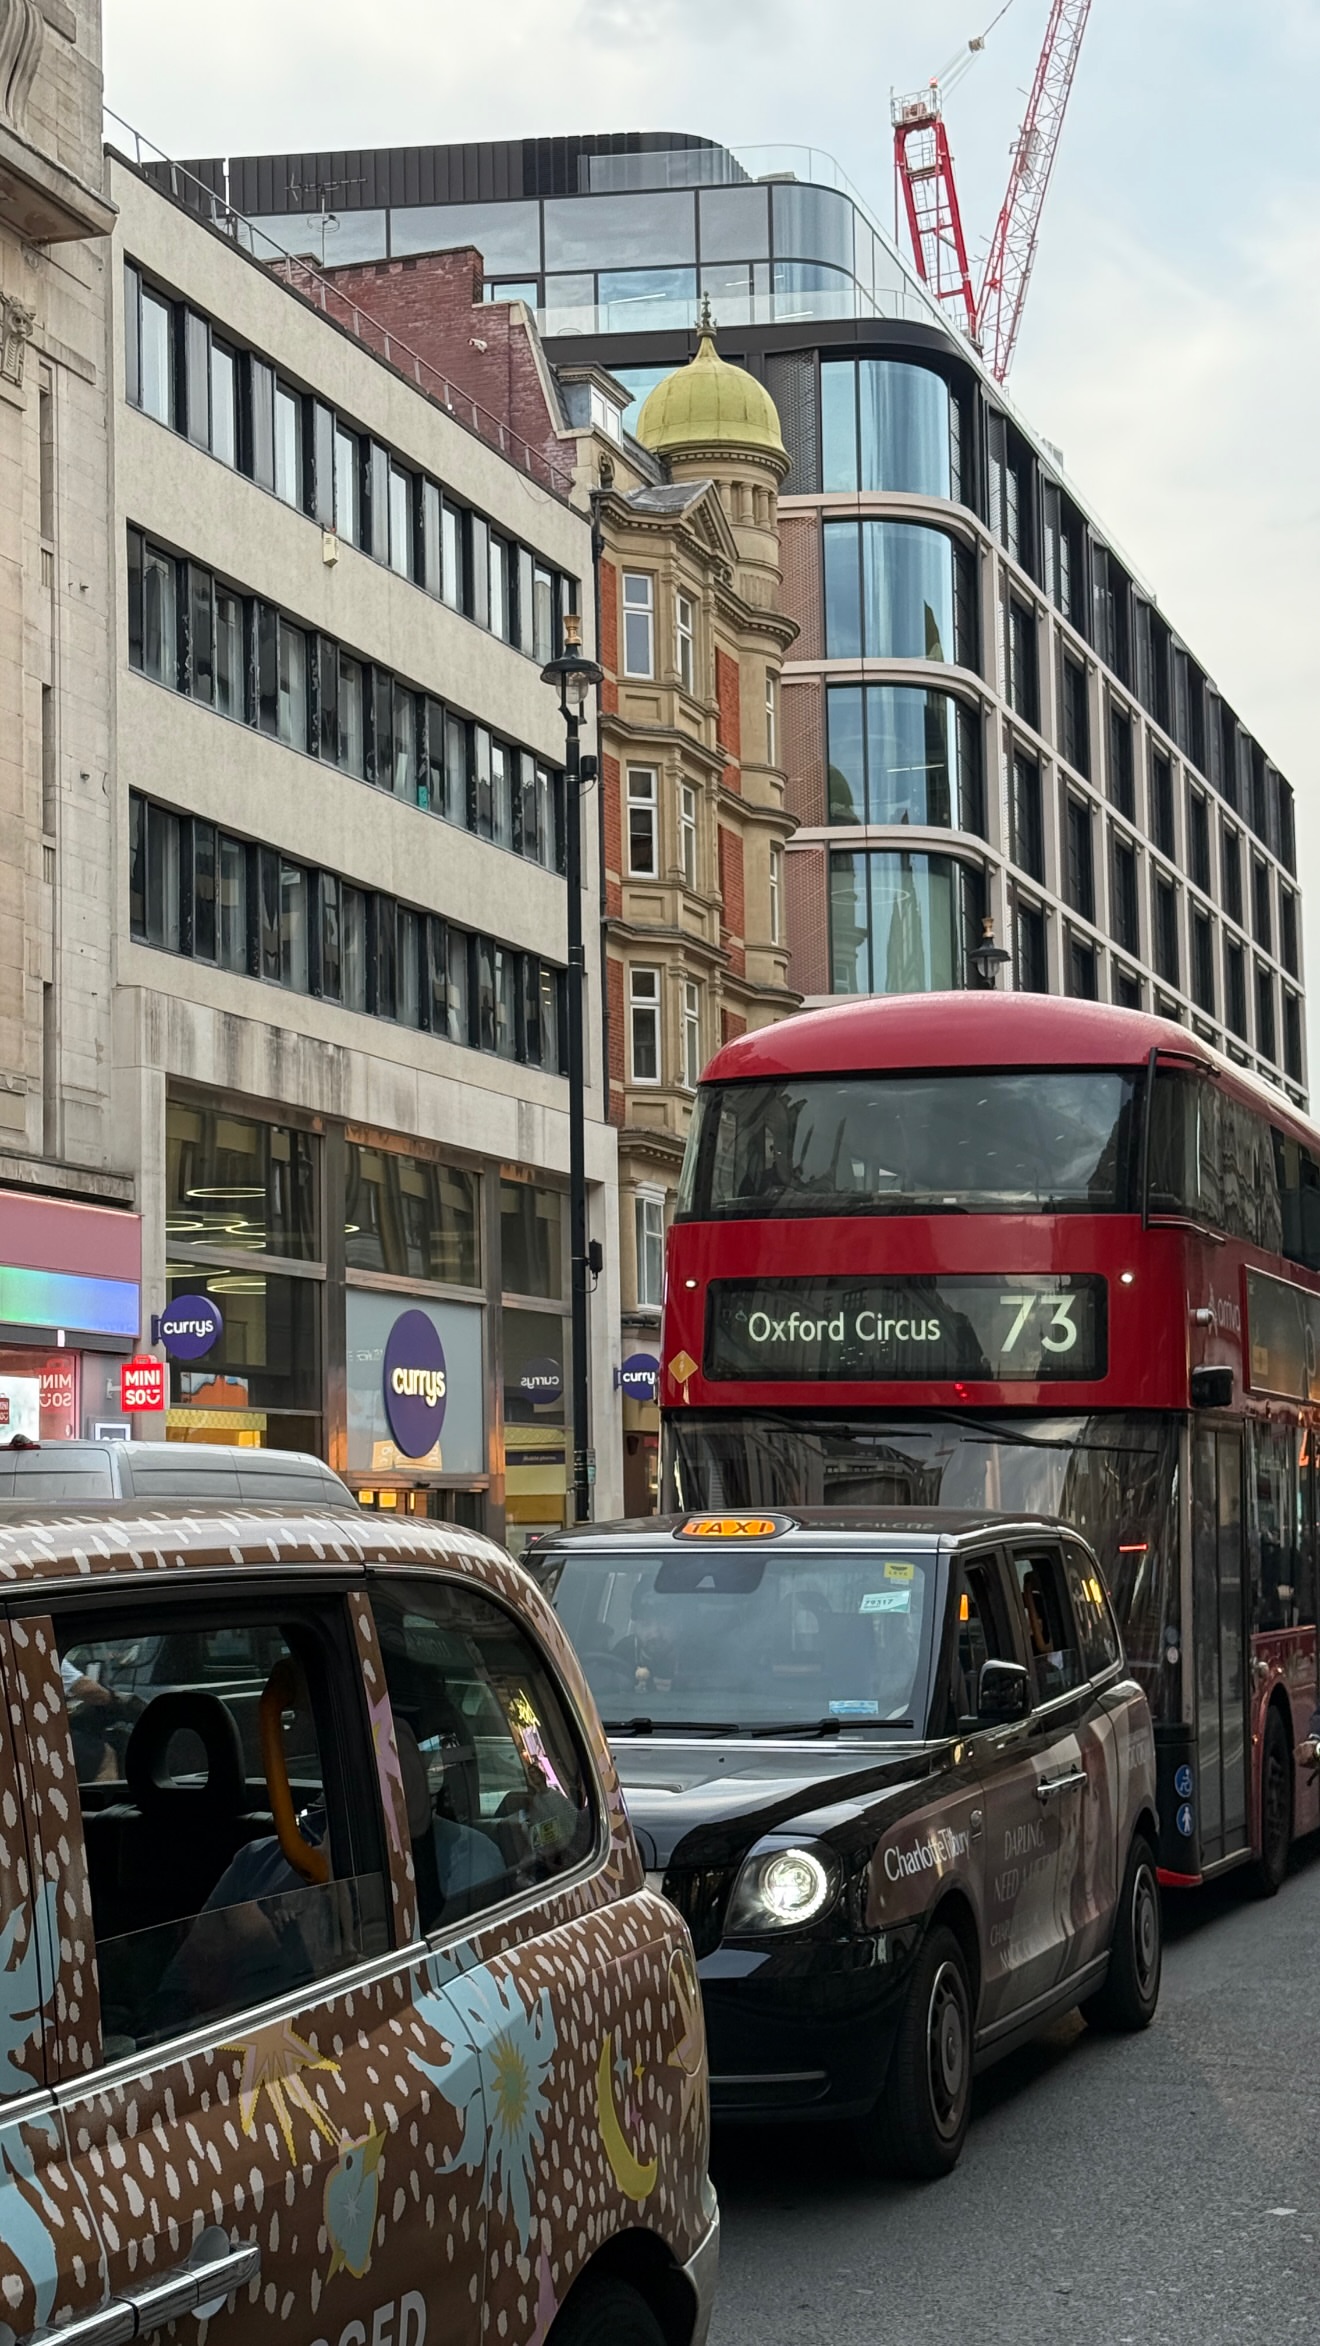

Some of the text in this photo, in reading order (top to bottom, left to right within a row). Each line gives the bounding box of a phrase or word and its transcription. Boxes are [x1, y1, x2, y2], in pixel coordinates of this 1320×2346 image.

[163, 1319, 214, 1338] currys
[748, 1311, 941, 1343] Oxford Circus
[1000, 1294, 1078, 1353] 73
[125, 1370, 160, 1386] MINI
[392, 1367, 446, 1408] currys
[622, 1371, 656, 1385] curry
[691, 1521, 767, 1534] TAXI
[884, 1837, 948, 1882] Charlotte
